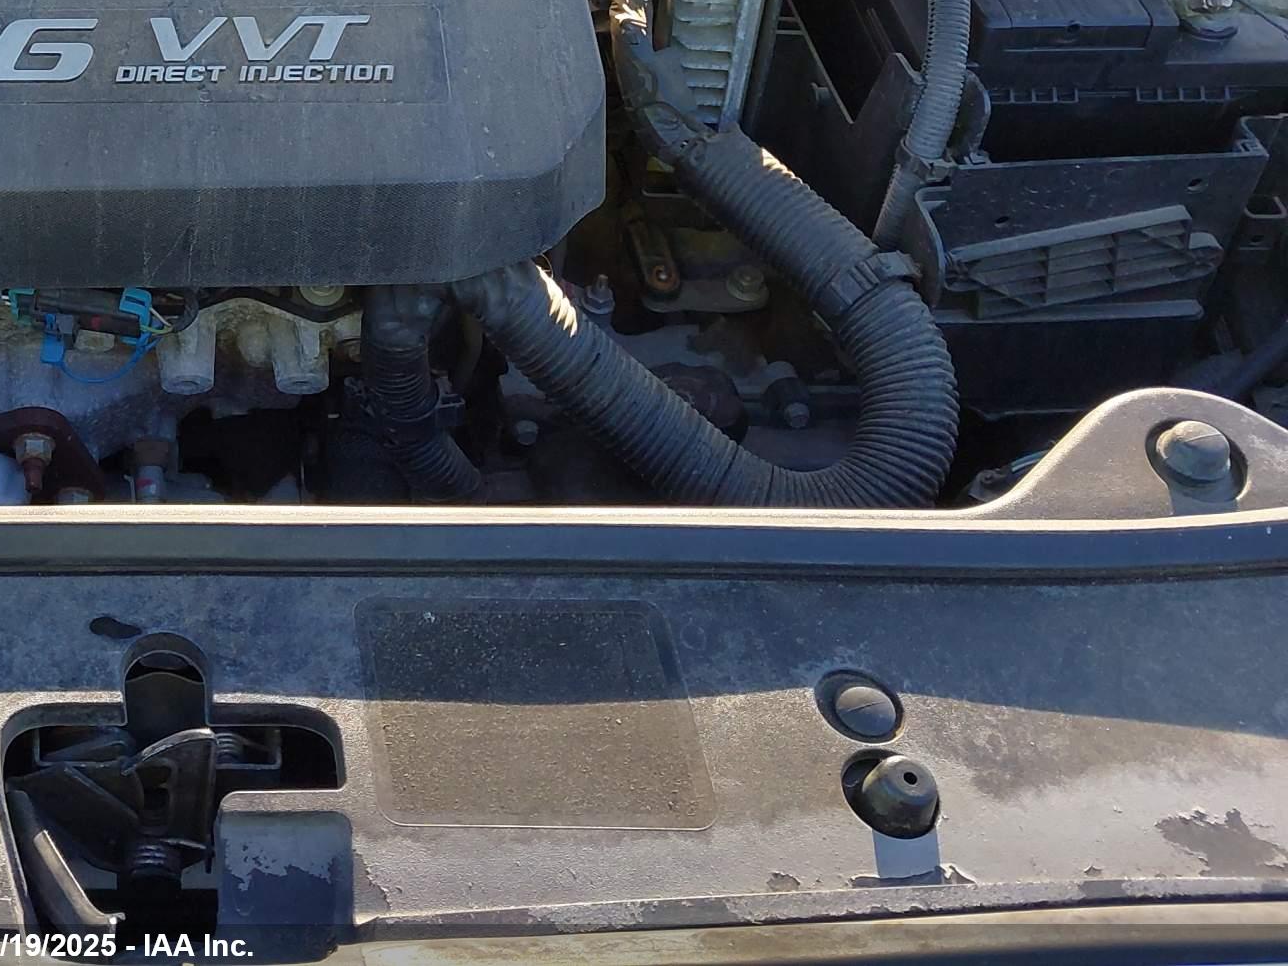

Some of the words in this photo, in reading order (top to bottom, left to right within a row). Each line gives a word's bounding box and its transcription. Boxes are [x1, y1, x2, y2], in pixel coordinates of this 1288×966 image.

[149, 14, 371, 62] VVT
[115, 65, 227, 82] DIRECT
[238, 64, 394, 82] INJECTION
